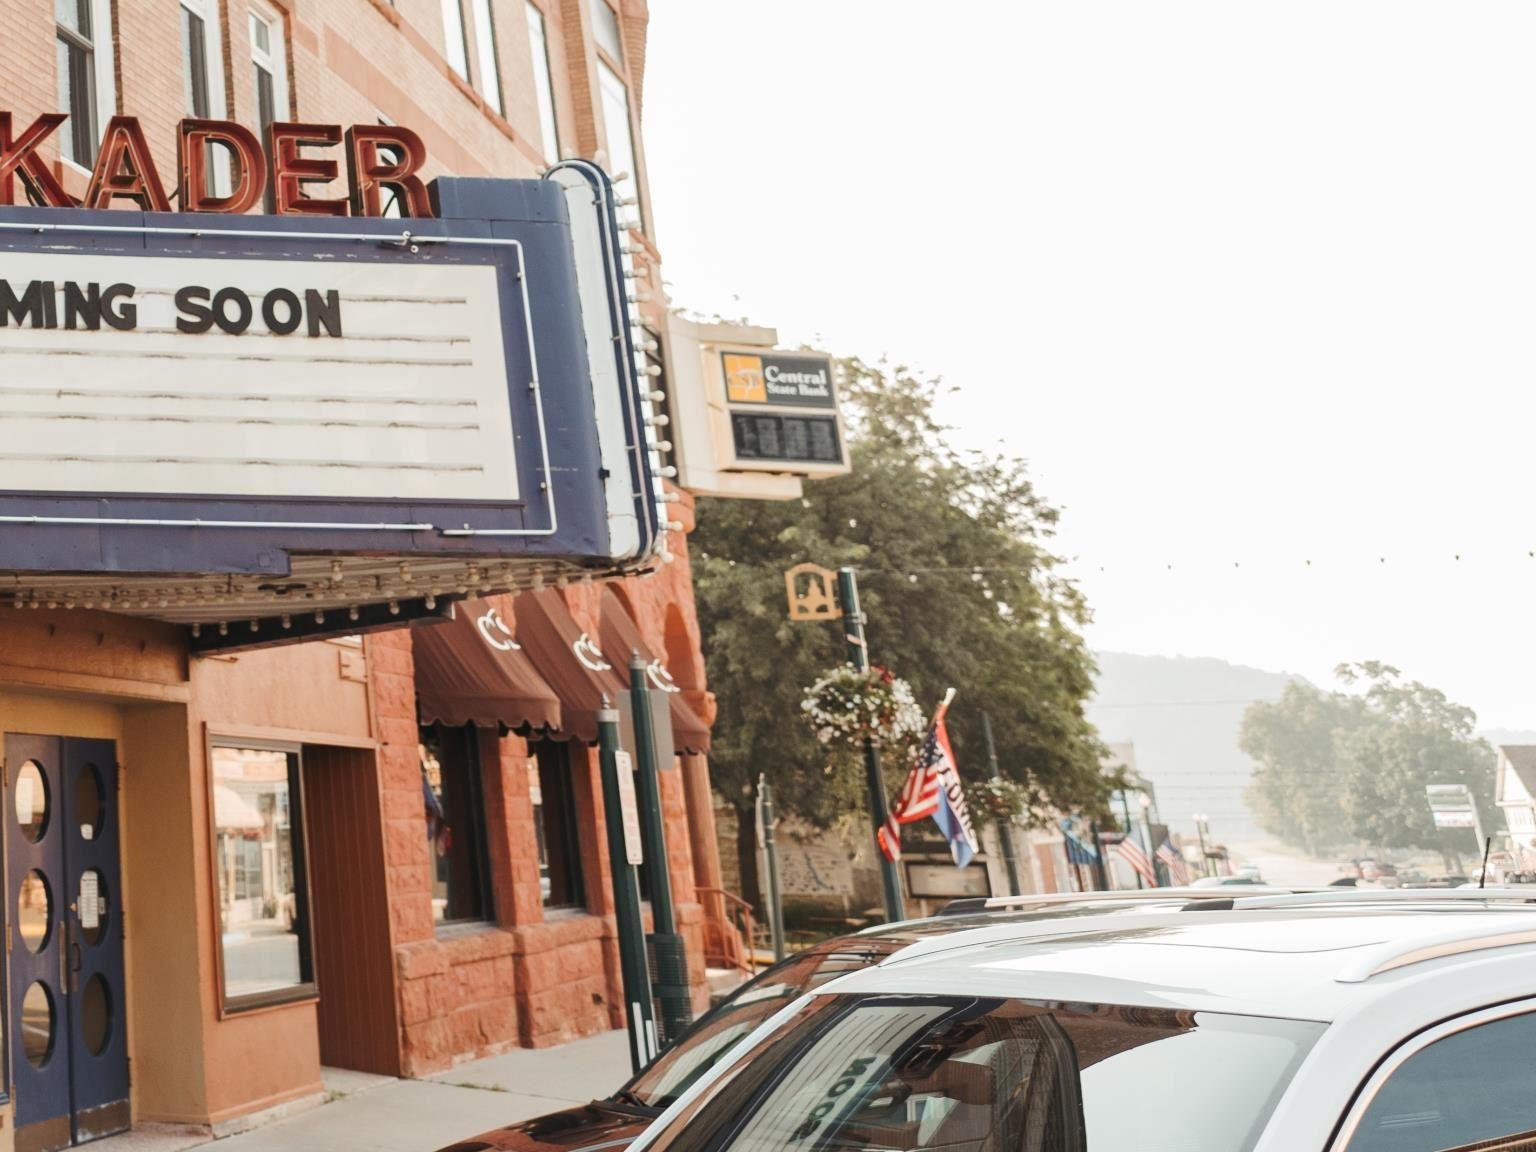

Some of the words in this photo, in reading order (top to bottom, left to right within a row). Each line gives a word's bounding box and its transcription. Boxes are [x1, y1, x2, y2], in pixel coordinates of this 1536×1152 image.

[175, 285, 342, 338] SOON
[765, 365, 827, 384] Central
[767, 382, 797, 395] State
